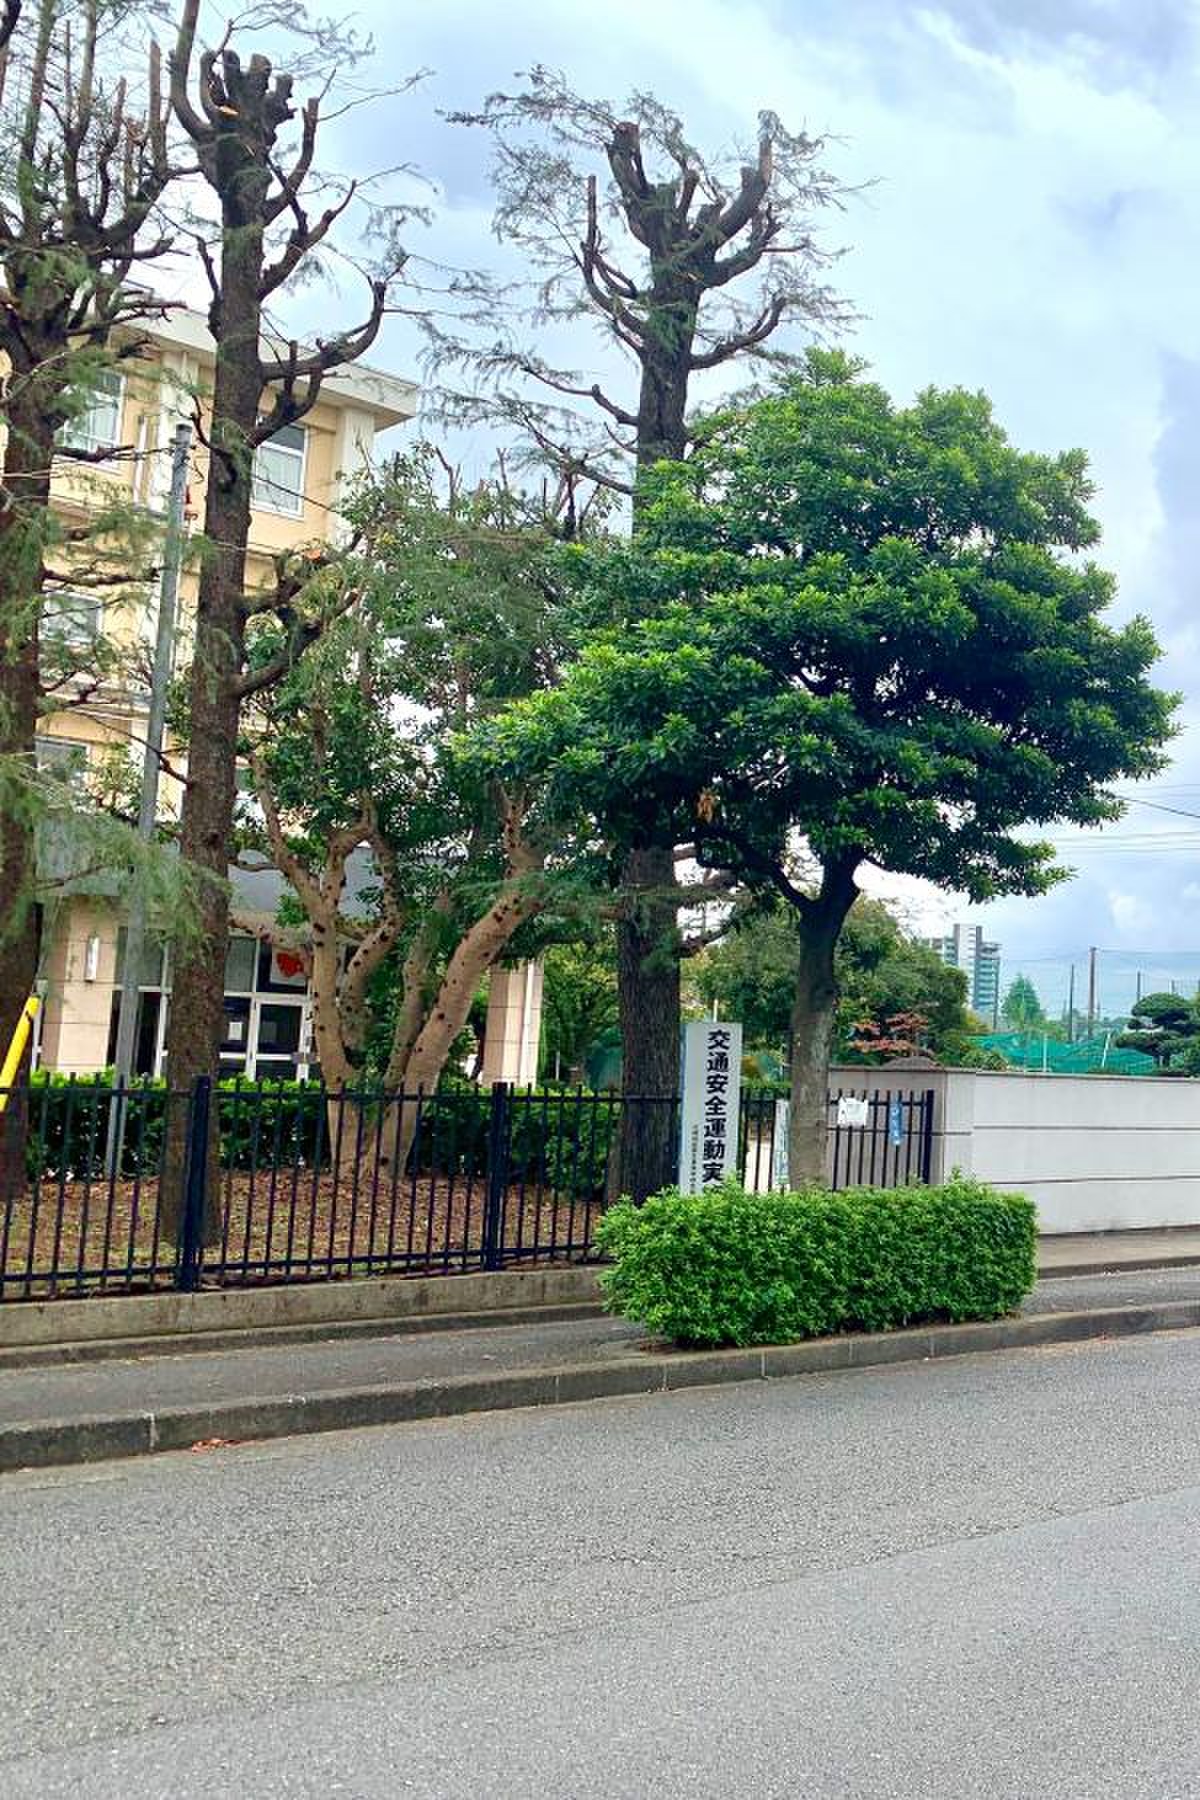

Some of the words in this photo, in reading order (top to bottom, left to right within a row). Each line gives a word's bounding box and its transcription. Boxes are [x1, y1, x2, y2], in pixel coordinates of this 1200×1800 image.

[702, 1029, 731, 1193] 交通安全運動実
